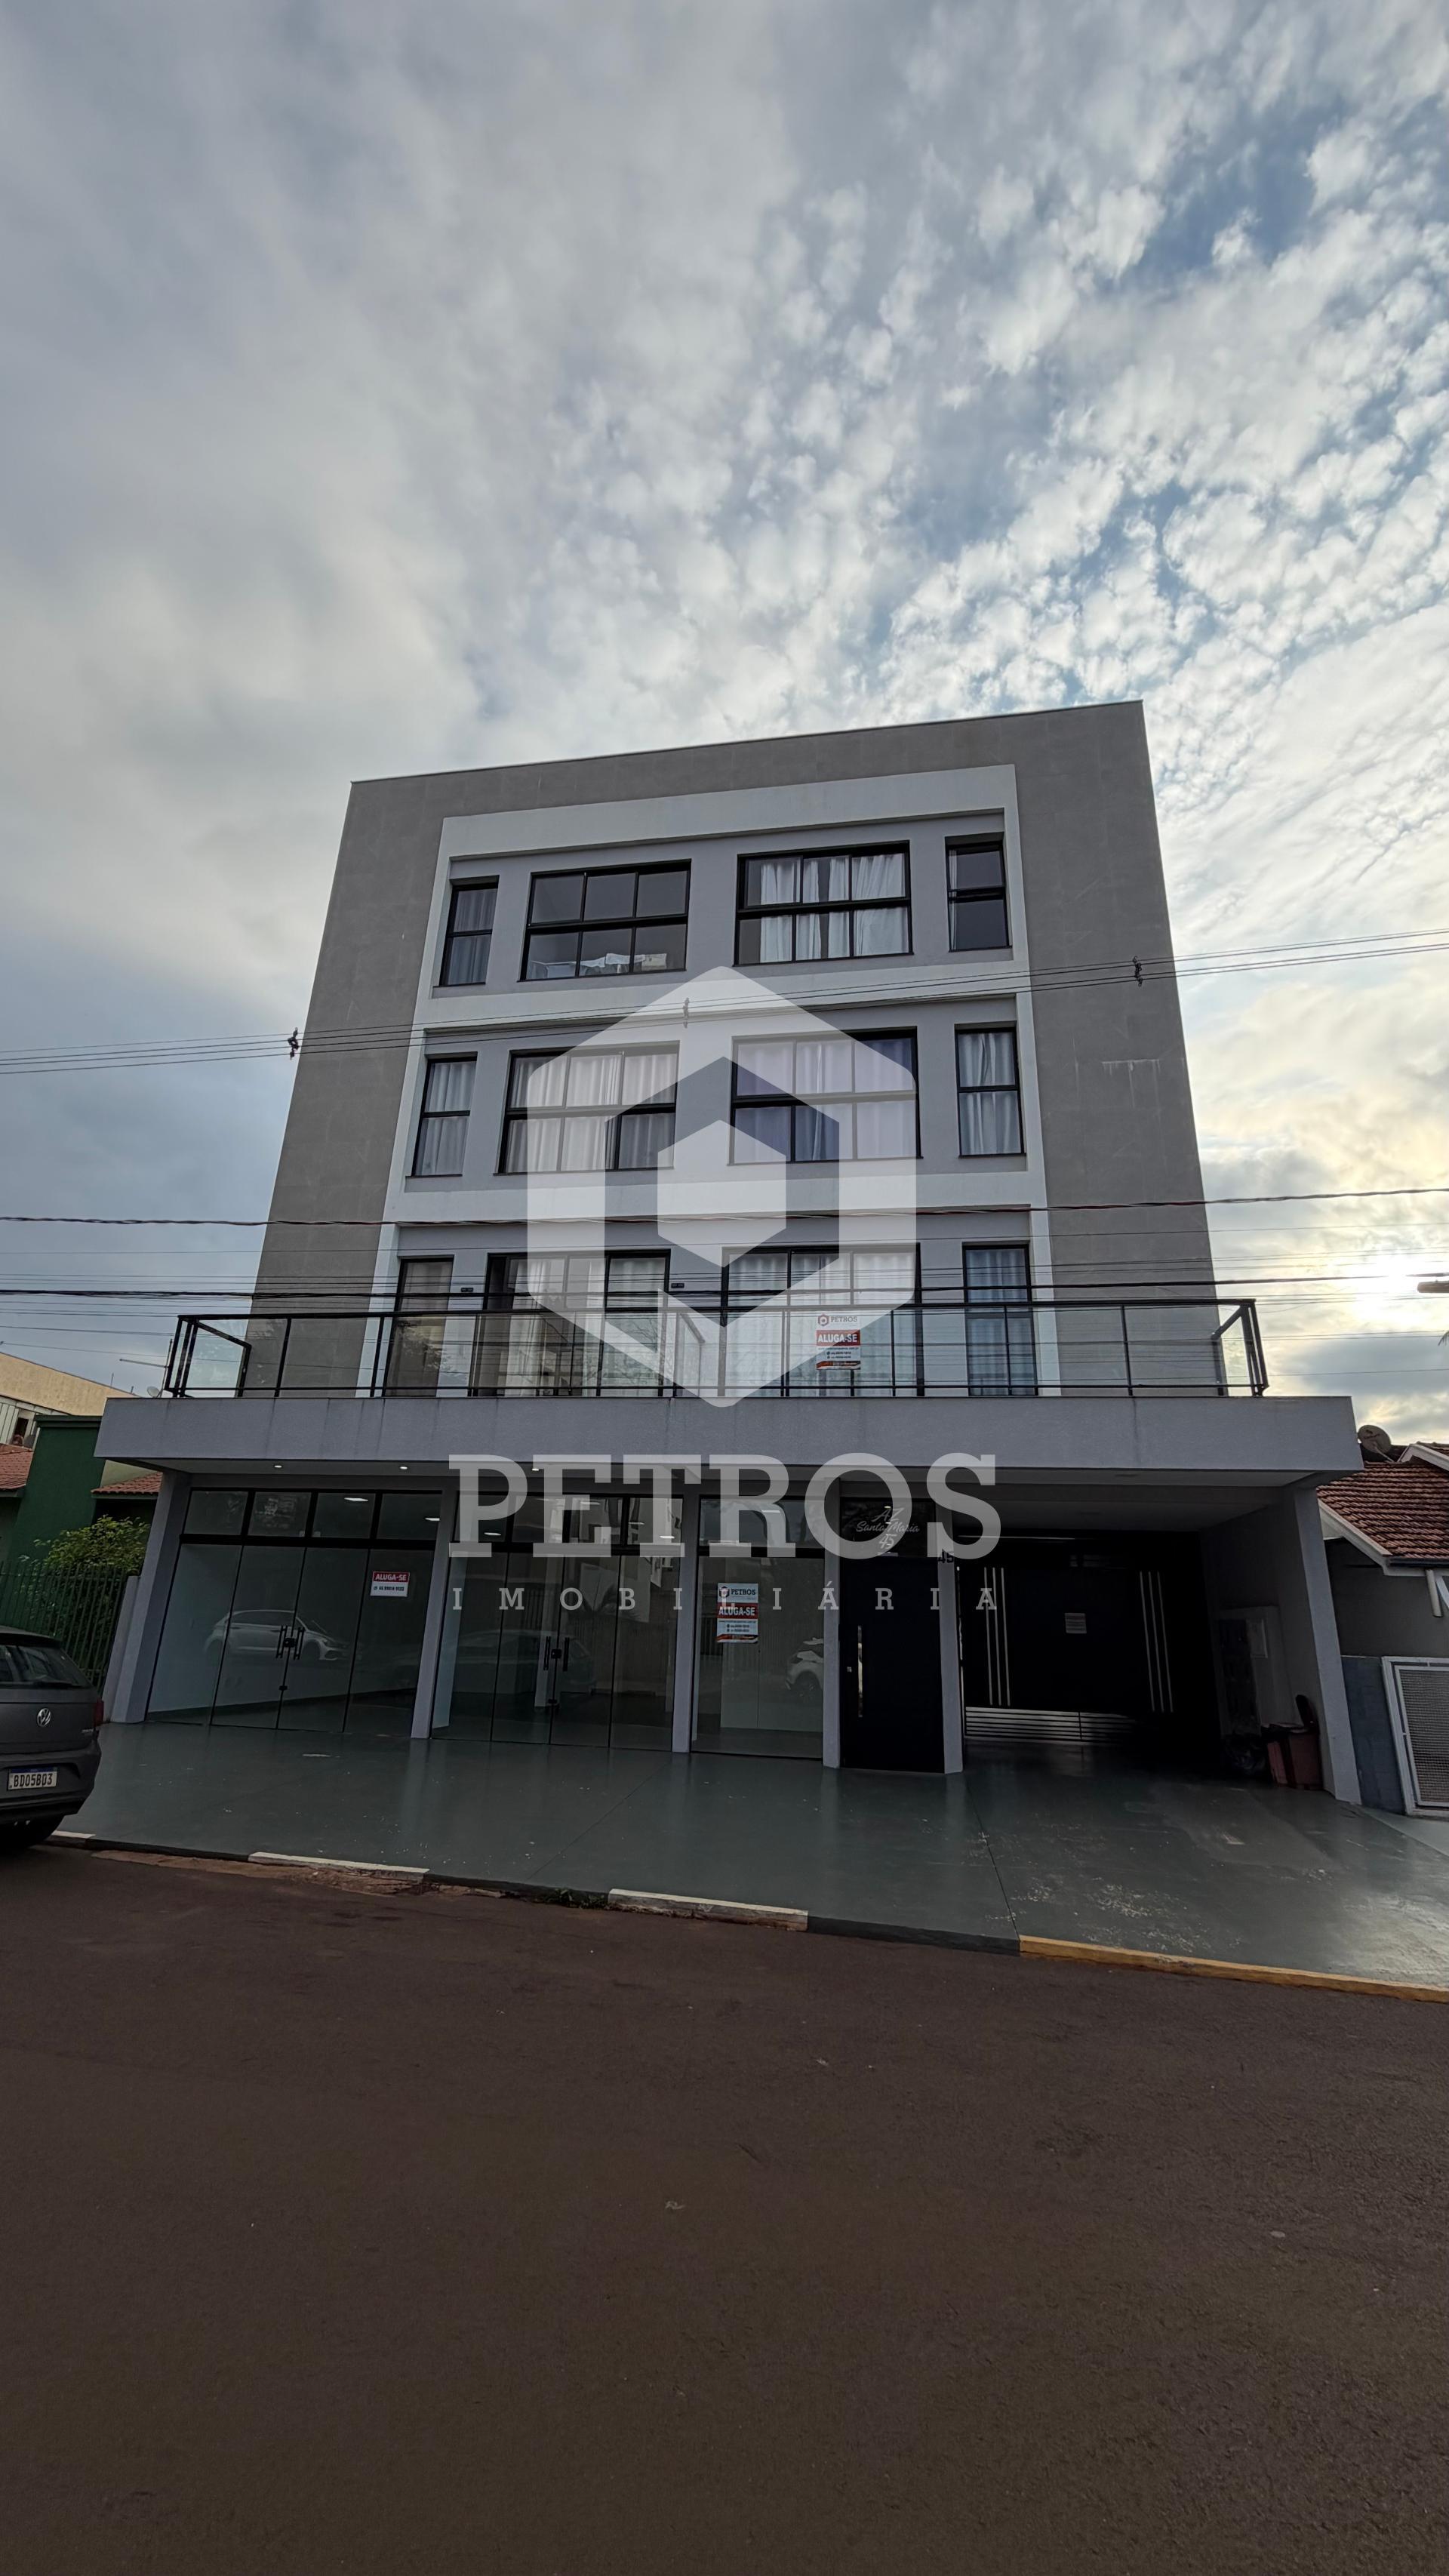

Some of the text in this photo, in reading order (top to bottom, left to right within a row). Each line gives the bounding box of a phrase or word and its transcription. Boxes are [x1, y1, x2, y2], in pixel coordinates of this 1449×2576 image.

[818, 1334, 858, 1343] ALUGA-SE
[856, 1521, 920, 1532] Santa Maria
[878, 1534, 897, 1550] 45
[718, 1606, 755, 1616] ALUGA-SE
